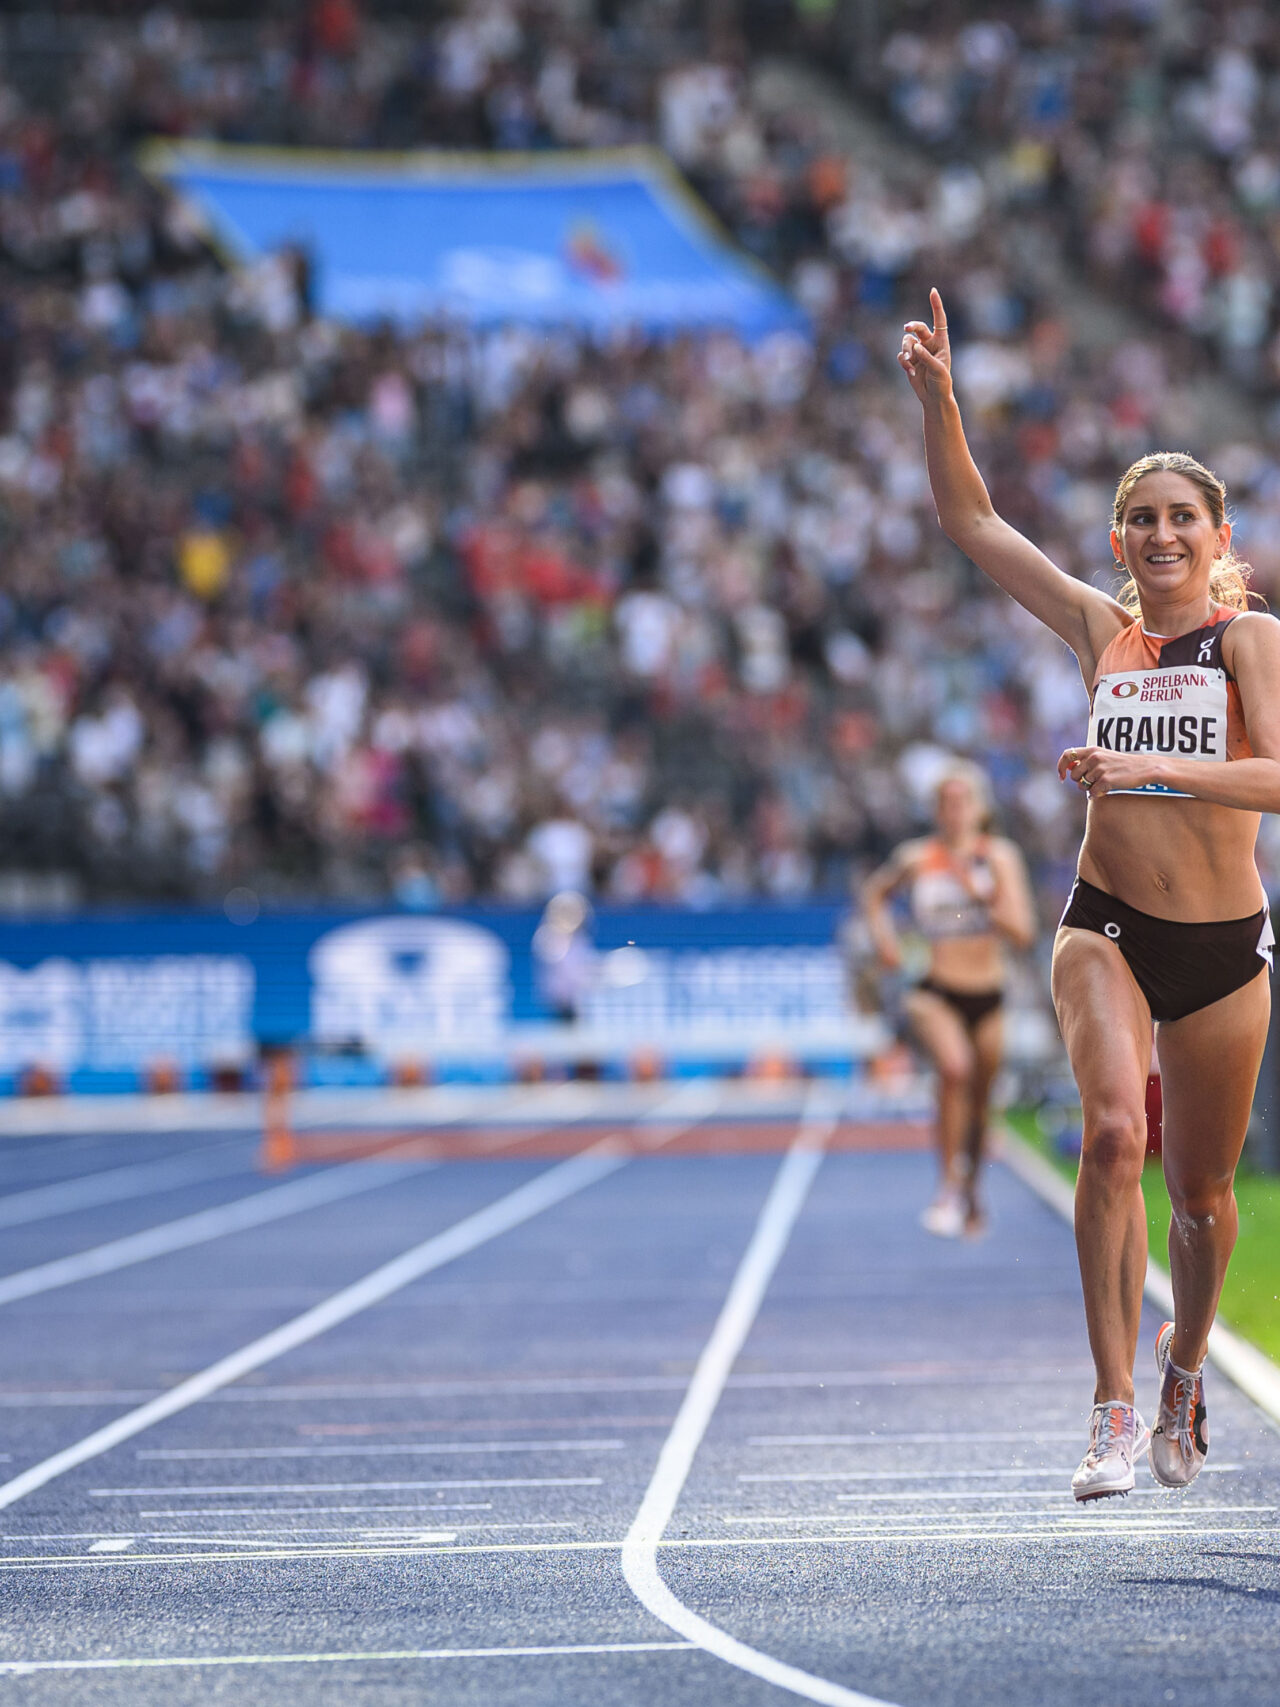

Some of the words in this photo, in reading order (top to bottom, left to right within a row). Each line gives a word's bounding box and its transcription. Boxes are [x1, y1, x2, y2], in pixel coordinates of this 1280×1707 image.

[1142, 674, 1209, 690] SPIELBANK
[1140, 688, 1183, 702] BERLIN
[1097, 716, 1217, 754] KRAUSE
